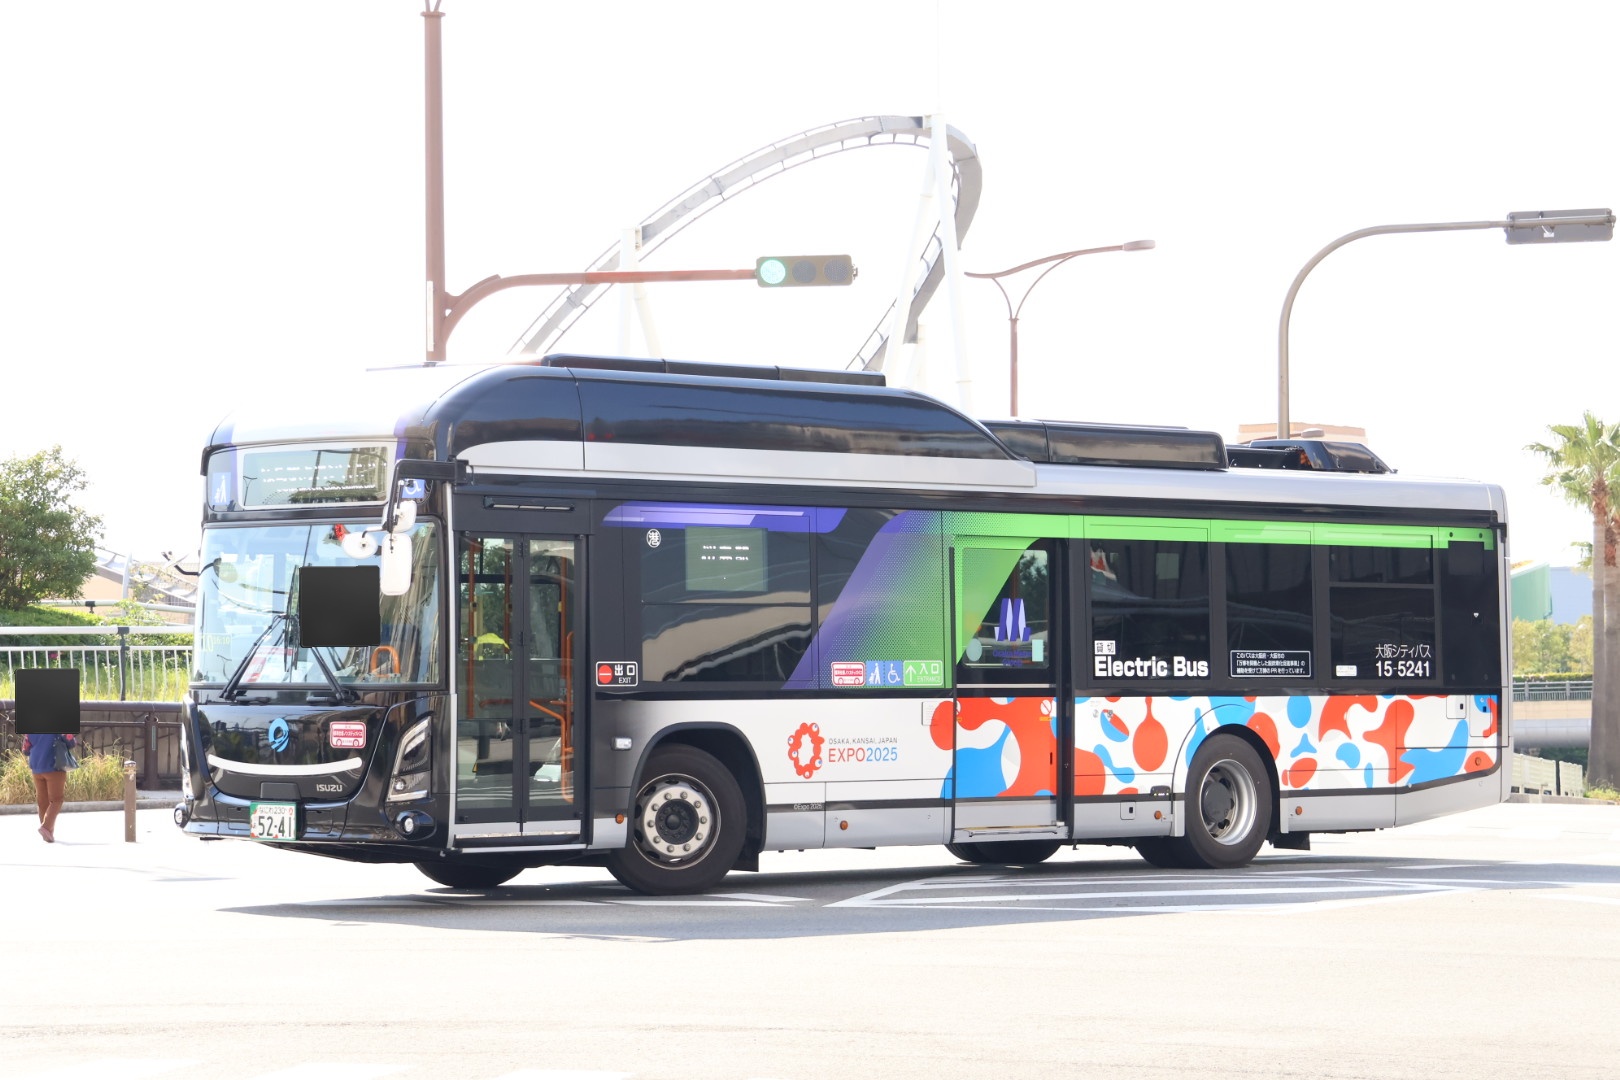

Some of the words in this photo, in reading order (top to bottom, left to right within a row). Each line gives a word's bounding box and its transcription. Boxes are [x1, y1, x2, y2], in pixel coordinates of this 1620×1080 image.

[614, 664, 635, 676] 出口
[919, 663, 939, 674] 入口
[1094, 655, 1168, 677] Electric
[1173, 655, 1209, 677] Bus
[1375, 660, 1430, 677] 15-5241
[828, 747, 898, 762] EXPO2025
[316, 784, 343, 792] ISUZU
